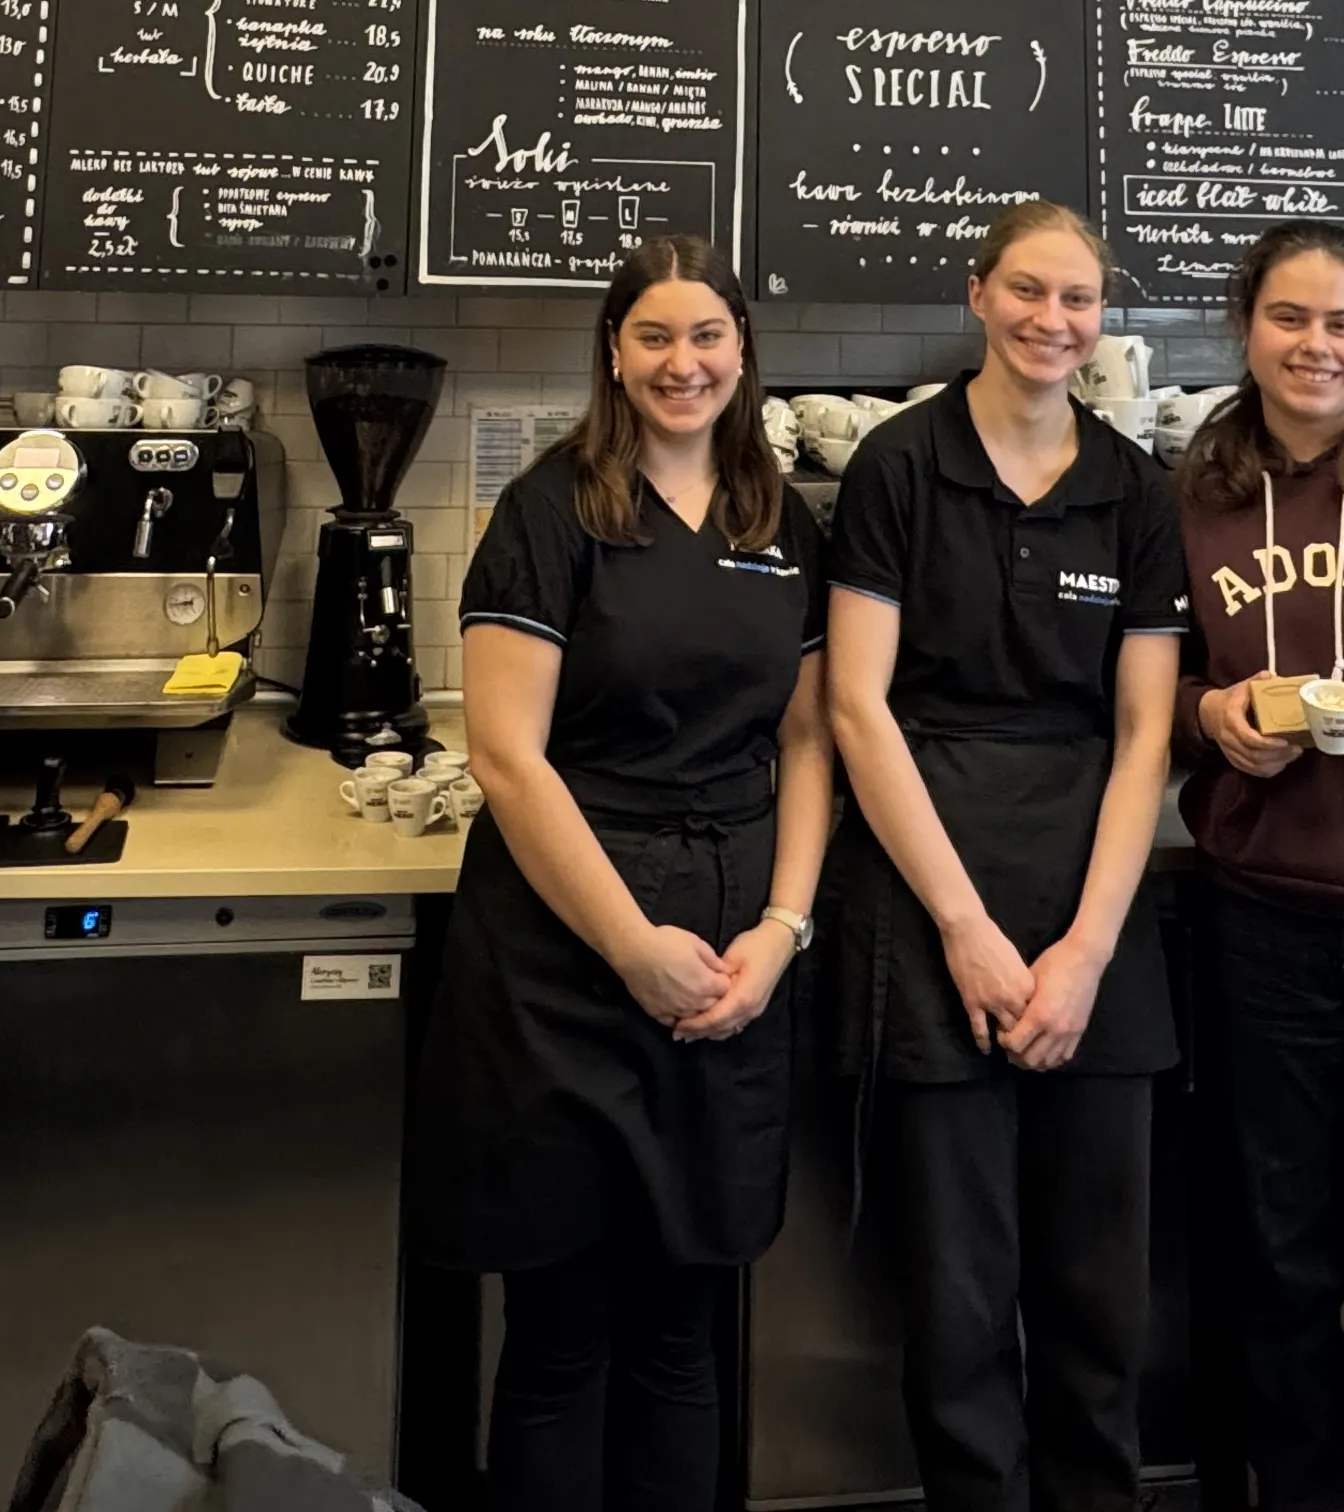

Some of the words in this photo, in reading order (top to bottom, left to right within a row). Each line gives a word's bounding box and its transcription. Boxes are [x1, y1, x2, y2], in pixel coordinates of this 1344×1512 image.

[236, 18, 327, 37] kanapka
[364, 24, 401, 48] 18,5
[476, 26, 506, 40] na
[836, 27, 1002, 58] espresso
[1126, 38, 1196, 63] Freddo
[1212, 39, 1302, 66] Espresso
[110, 46, 184, 65] herbata
[242, 61, 314, 86] QUICHE
[575, 79, 613, 92] MALINA
[845, 64, 992, 110] SPECIAL
[360, 98, 400, 122] 17,9
[1129, 95, 1212, 138] frappe
[1223, 103, 1268, 132] LATTE
[467, 114, 578, 173] Soki
[70, 158, 107, 172] MLEKO
[113, 159, 133, 173] BEZ
[139, 160, 185, 175] LAKTOZY
[304, 167, 332, 181] CENIE
[339, 168, 375, 183] KAWY
[788, 170, 862, 202] kawa
[1136, 183, 1189, 207] iced
[1196, 181, 1258, 209] flat
[1262, 186, 1338, 213] white
[471, 247, 552, 269] POMARAŃCZA
[1157, 255, 1244, 272] Lemon
